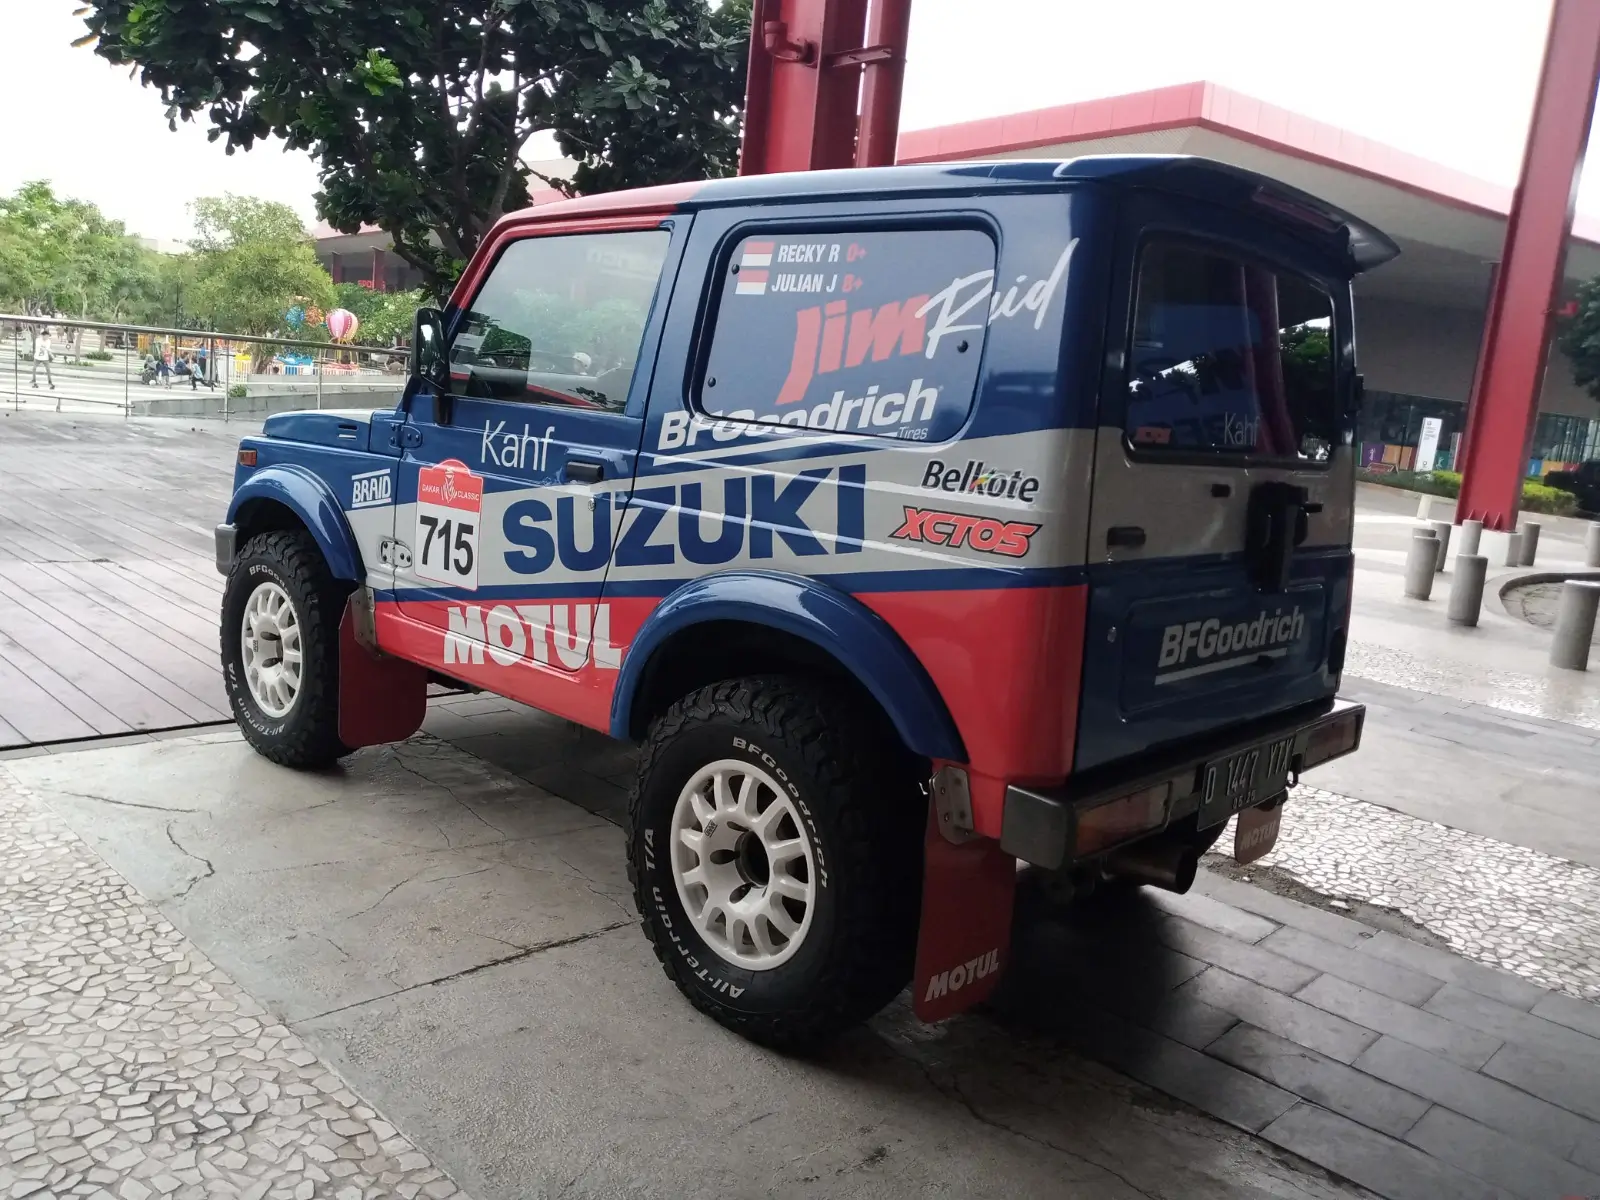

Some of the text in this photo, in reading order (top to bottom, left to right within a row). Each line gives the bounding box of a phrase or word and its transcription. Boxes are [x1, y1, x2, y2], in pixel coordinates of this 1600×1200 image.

[777, 244, 827, 263] RECKY
[828, 244, 840, 263] R
[771, 274, 825, 293] JULIAN
[826, 274, 838, 293] J
[657, 378, 939, 451] BFGoodrich
[898, 427, 929, 441] Tires
[1223, 411, 1261, 446] Kahf
[481, 419, 555, 472] Kahf
[352, 474, 392, 504] BRAID
[421, 484, 480, 502] DAKAR CLASSIC
[921, 460, 1039, 502] Belkote
[420, 515, 474, 576] 715
[502, 464, 866, 575] SUZUKI
[888, 505, 1043, 558] XCTOS
[443, 603, 622, 669] MOTUL
[1158, 605, 1305, 669] BFGoodrich
[1226, 750, 1260, 796] 1447
[732, 735, 829, 889] BFGoodrich
[644, 828, 746, 1000] All-Terrain T/A
[924, 948, 1000, 1002] MOTUL
